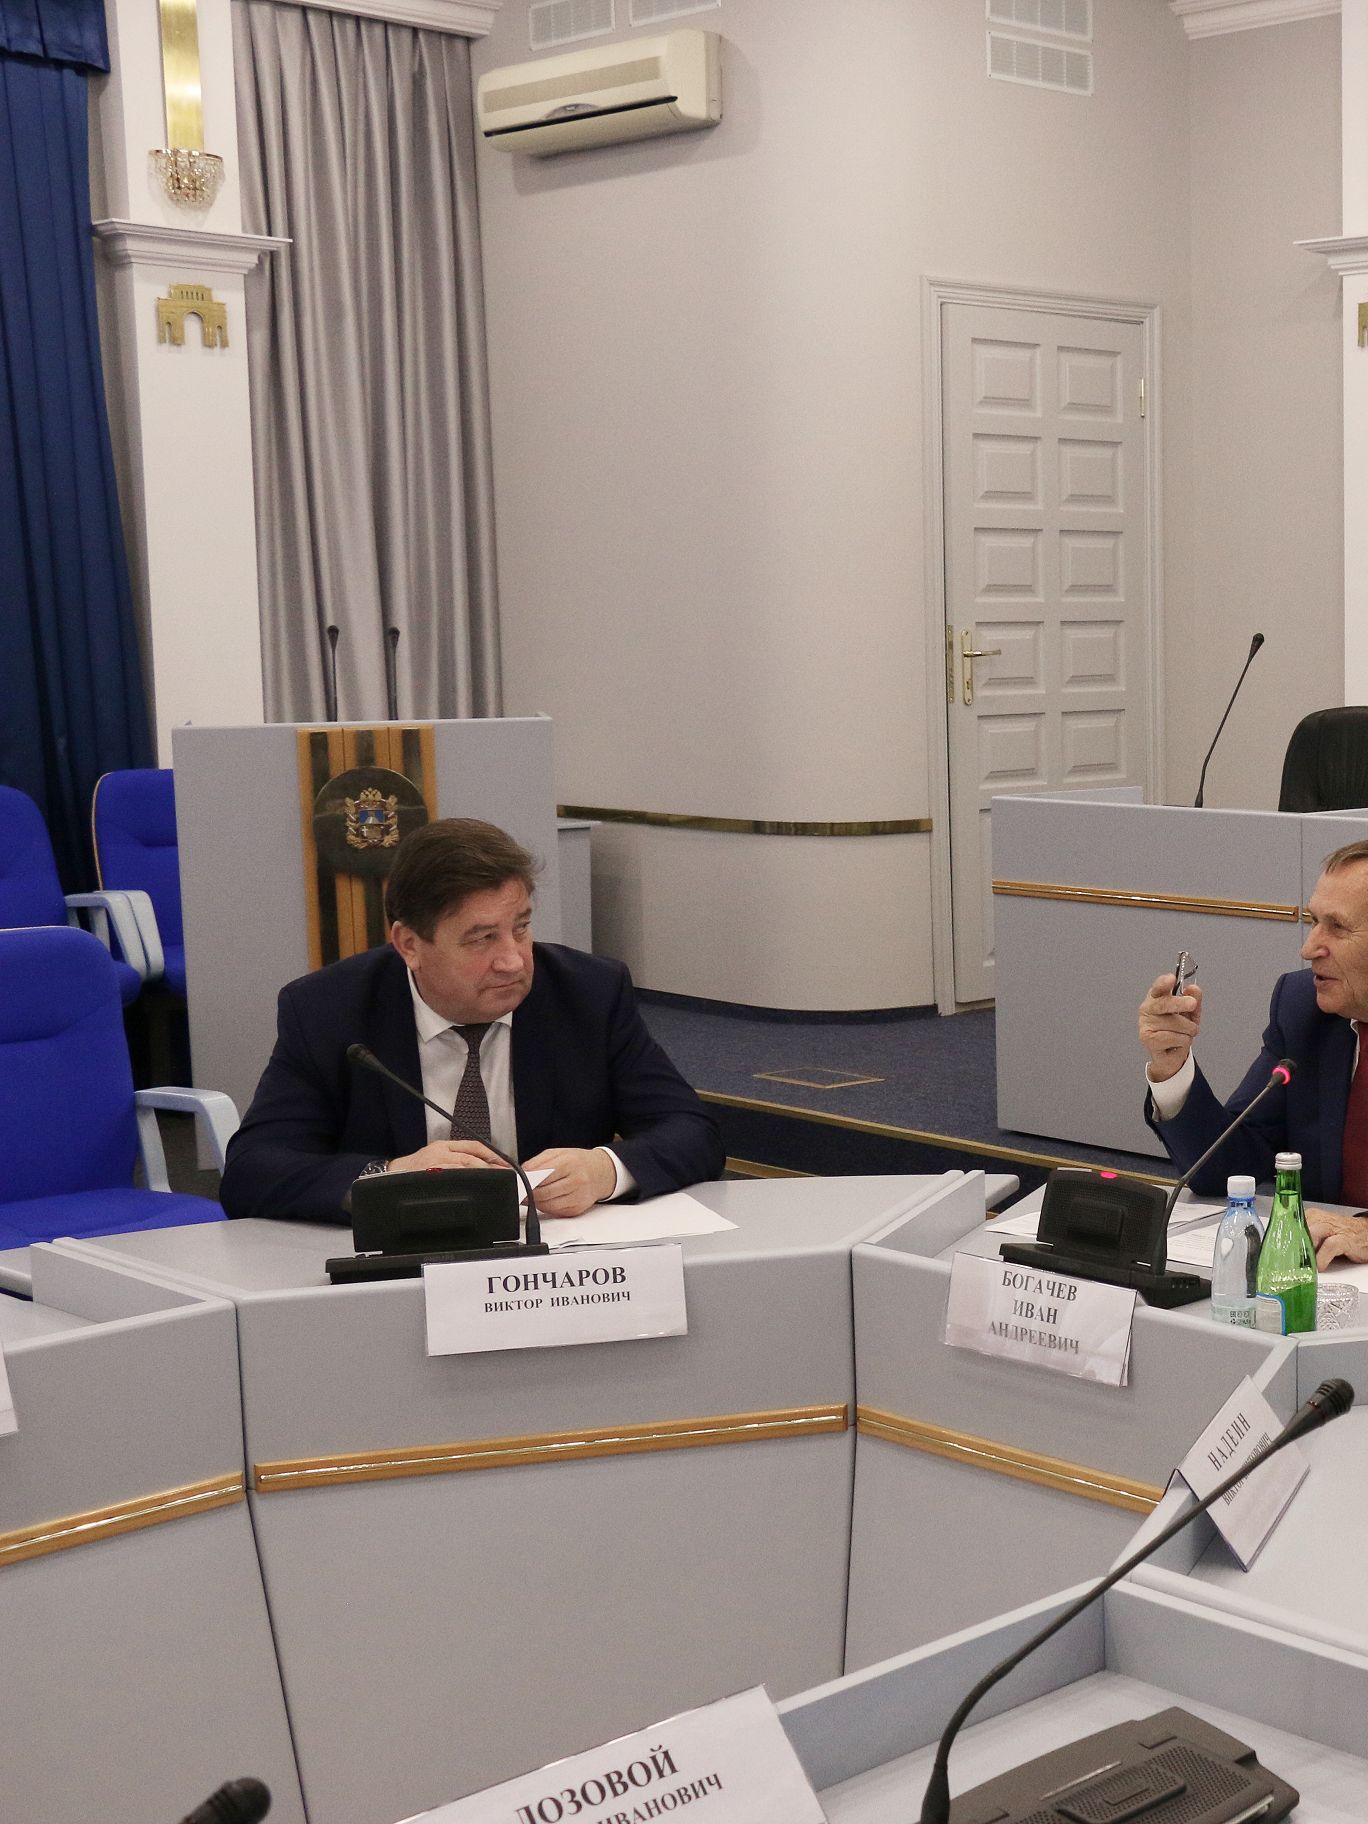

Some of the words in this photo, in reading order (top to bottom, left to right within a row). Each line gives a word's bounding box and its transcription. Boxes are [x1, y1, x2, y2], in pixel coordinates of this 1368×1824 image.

[487, 1266, 627, 1294] ГОНЧАРОВ
[1002, 1270, 1078, 1302] БОГАЧЕВ
[484, 1298, 543, 1313] ВИКТОР
[550, 1291, 631, 1308] ИВАНОВИЧ
[1012, 1299, 1058, 1325] ИВАН
[988, 1320, 1080, 1355] АНДРЕЕВИЧ
[1207, 1412, 1251, 1472] НАДЕИН
[514, 1744, 680, 1824] ЛОЗОВОЙ
